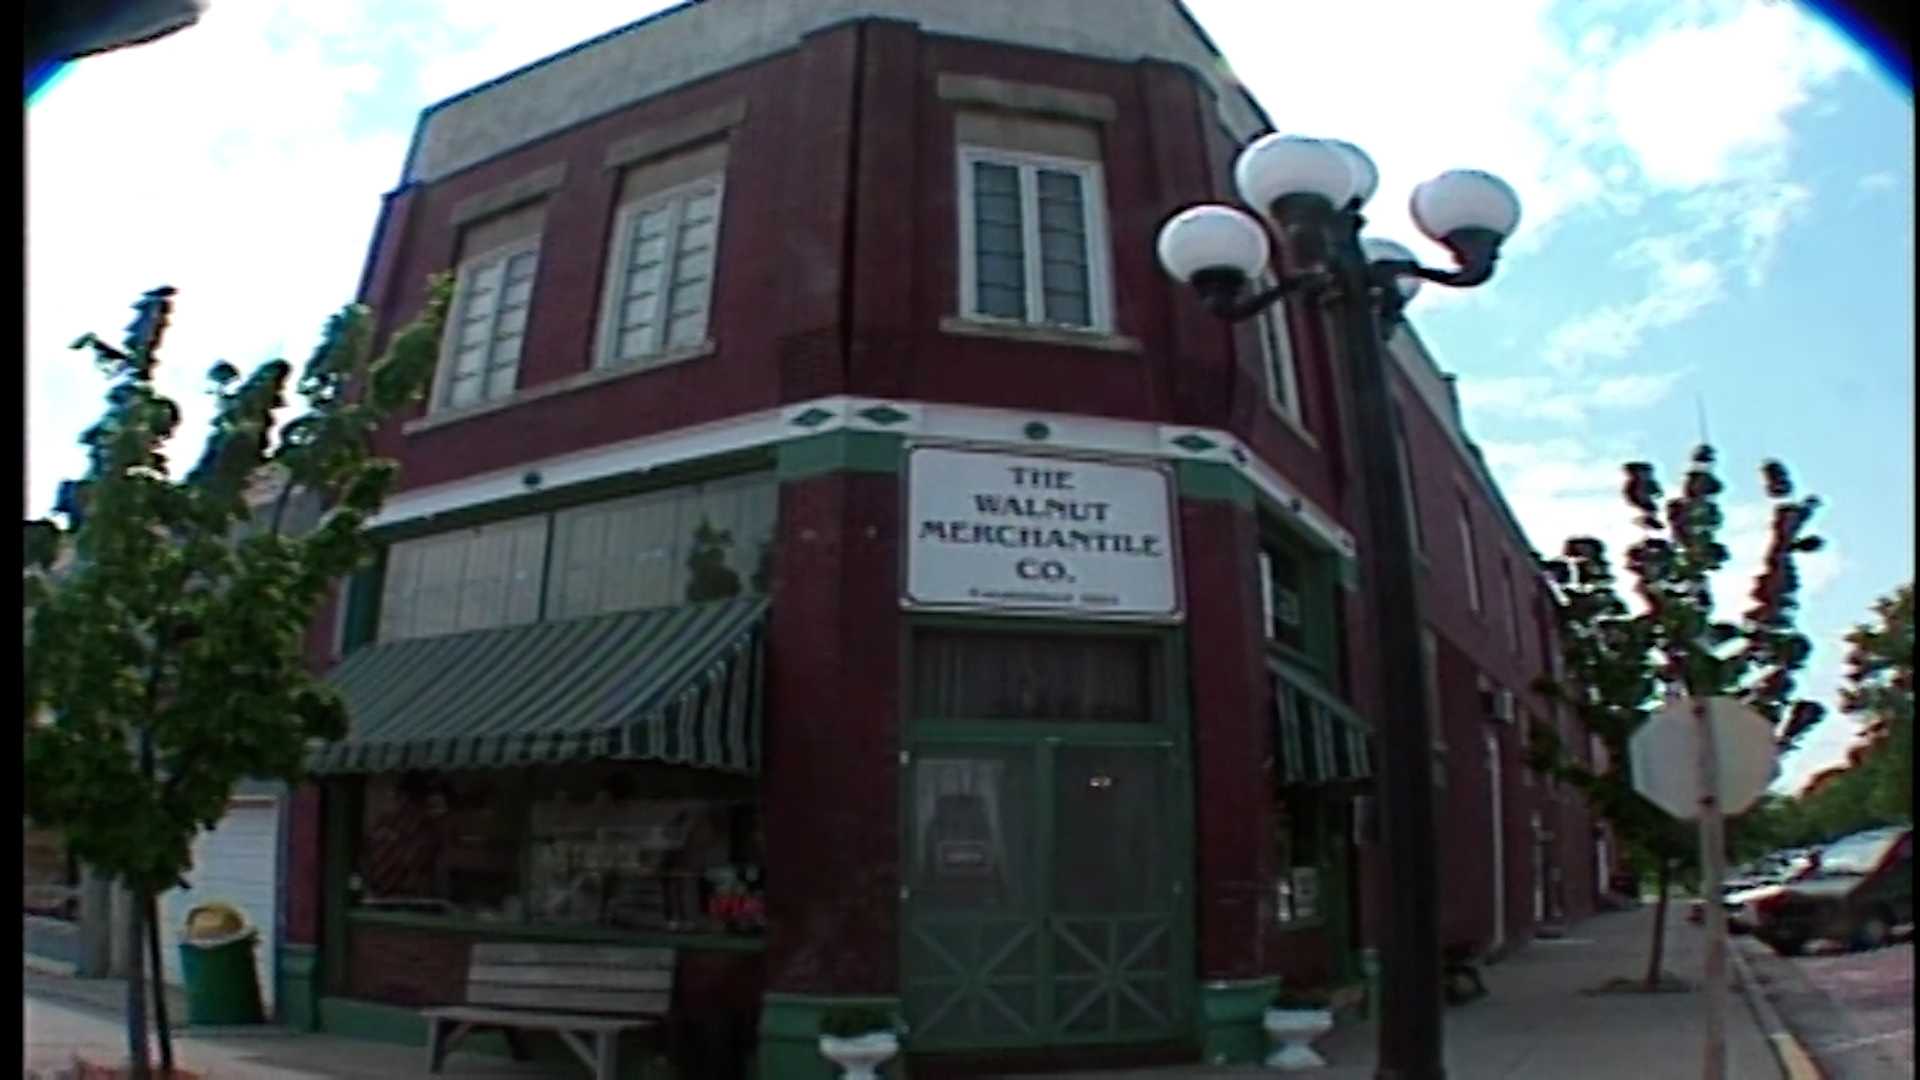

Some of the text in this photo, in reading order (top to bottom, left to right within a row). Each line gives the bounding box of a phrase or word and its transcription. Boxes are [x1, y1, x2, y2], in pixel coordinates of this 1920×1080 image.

[1009, 466, 1074, 490] THE
[973, 494, 1110, 521] WALNUT
[919, 521, 1162, 557] MERCHANTILE
[1016, 557, 1076, 583] CO.
